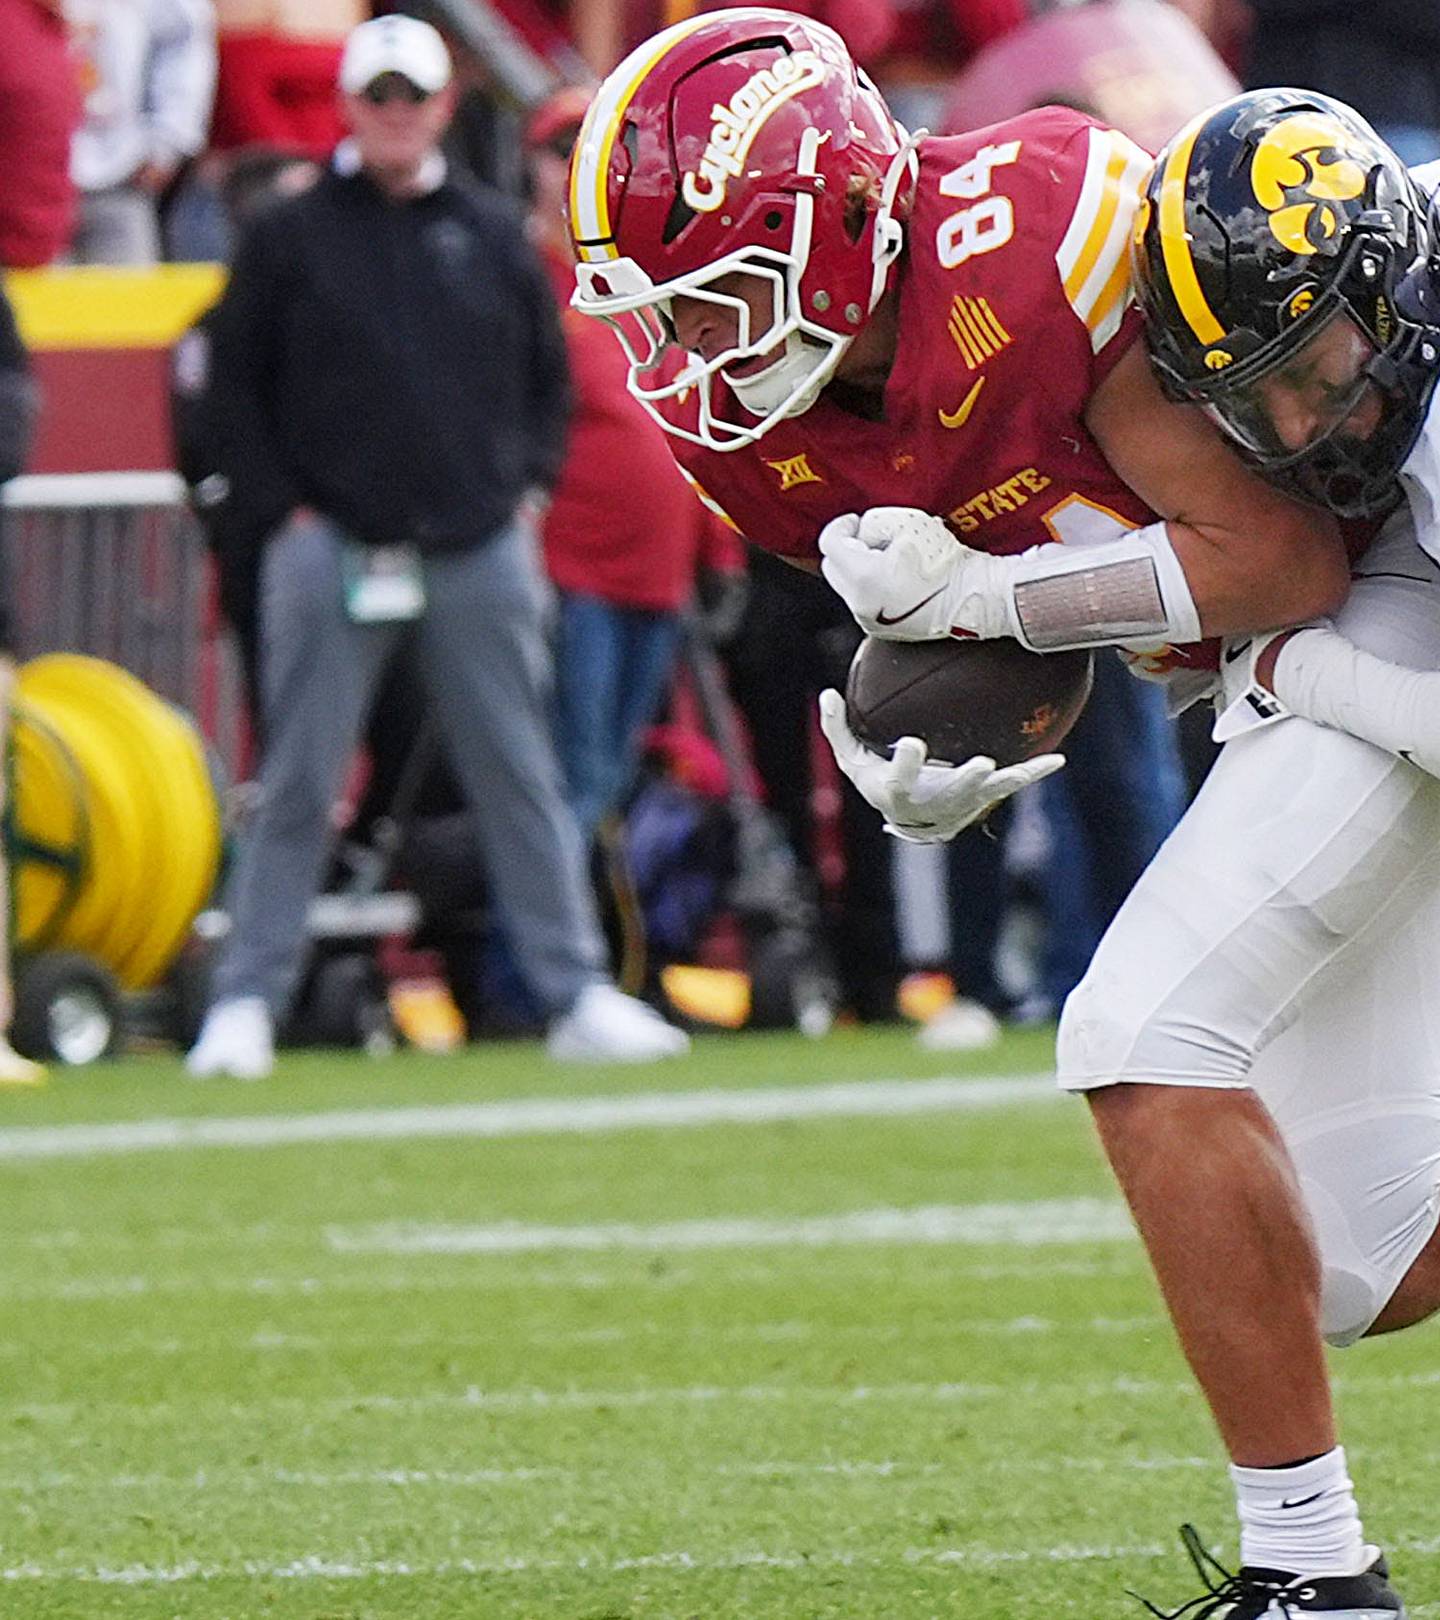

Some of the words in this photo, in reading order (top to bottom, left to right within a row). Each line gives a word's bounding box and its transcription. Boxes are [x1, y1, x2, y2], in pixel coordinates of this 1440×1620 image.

[682, 50, 826, 212] Cyclones
[936, 140, 1022, 270] 84
[767, 453, 824, 490] XII
[949, 467, 1051, 532] STATE
